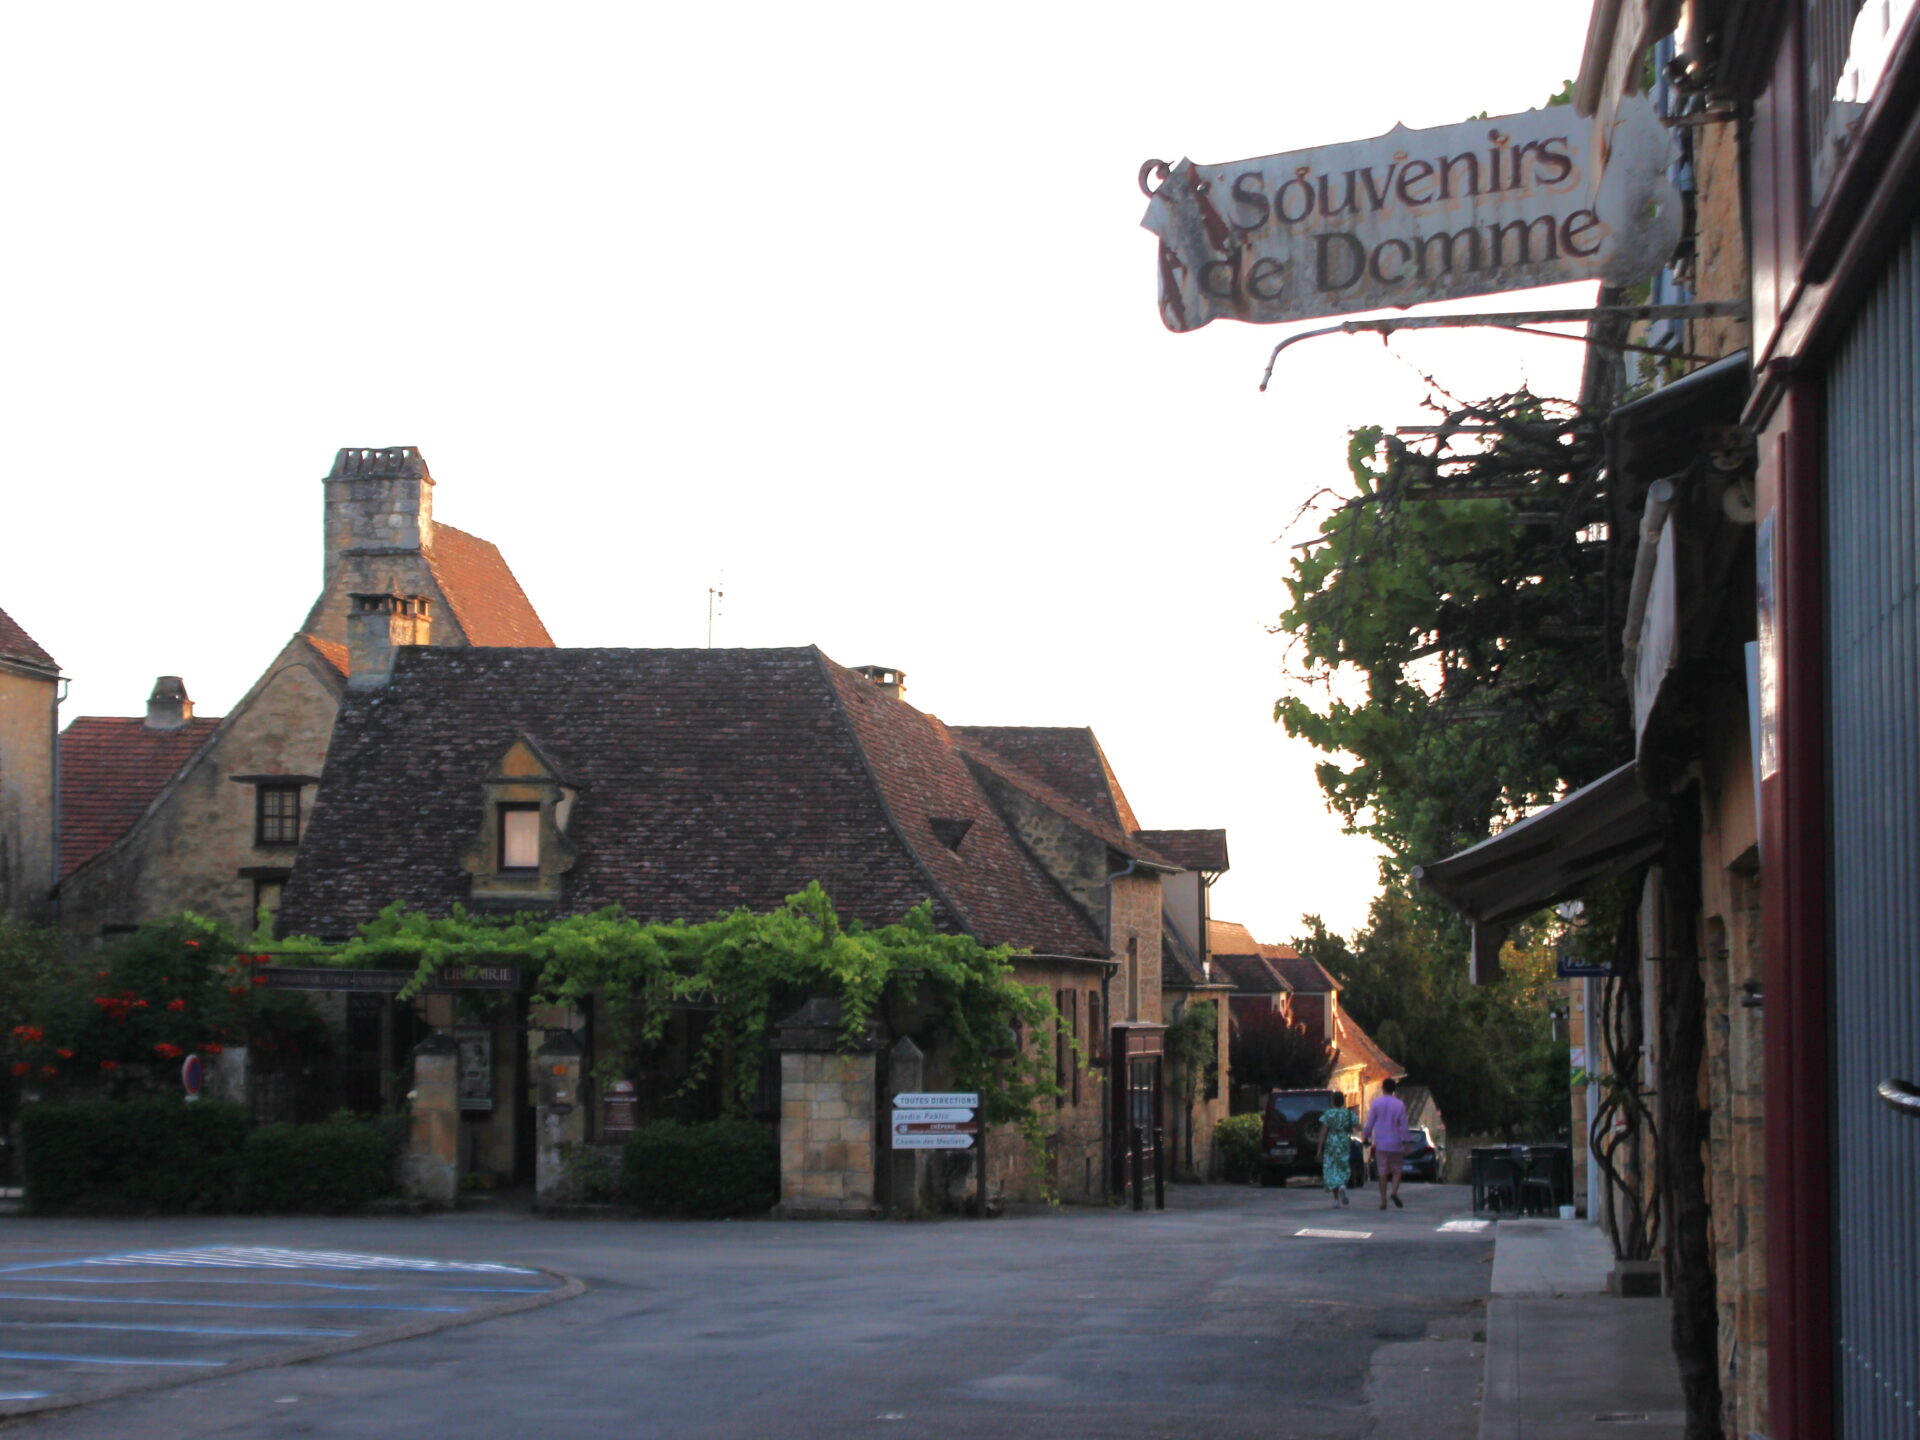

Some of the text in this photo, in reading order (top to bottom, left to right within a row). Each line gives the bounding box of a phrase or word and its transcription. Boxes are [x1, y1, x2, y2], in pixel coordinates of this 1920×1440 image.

[1230, 127, 1573, 233] Souvenirs
[1201, 207, 1601, 301] de Domme
[443, 967, 512, 981] LIBAIRIE
[900, 1097, 977, 1105] TOUTES DIRECTIONS
